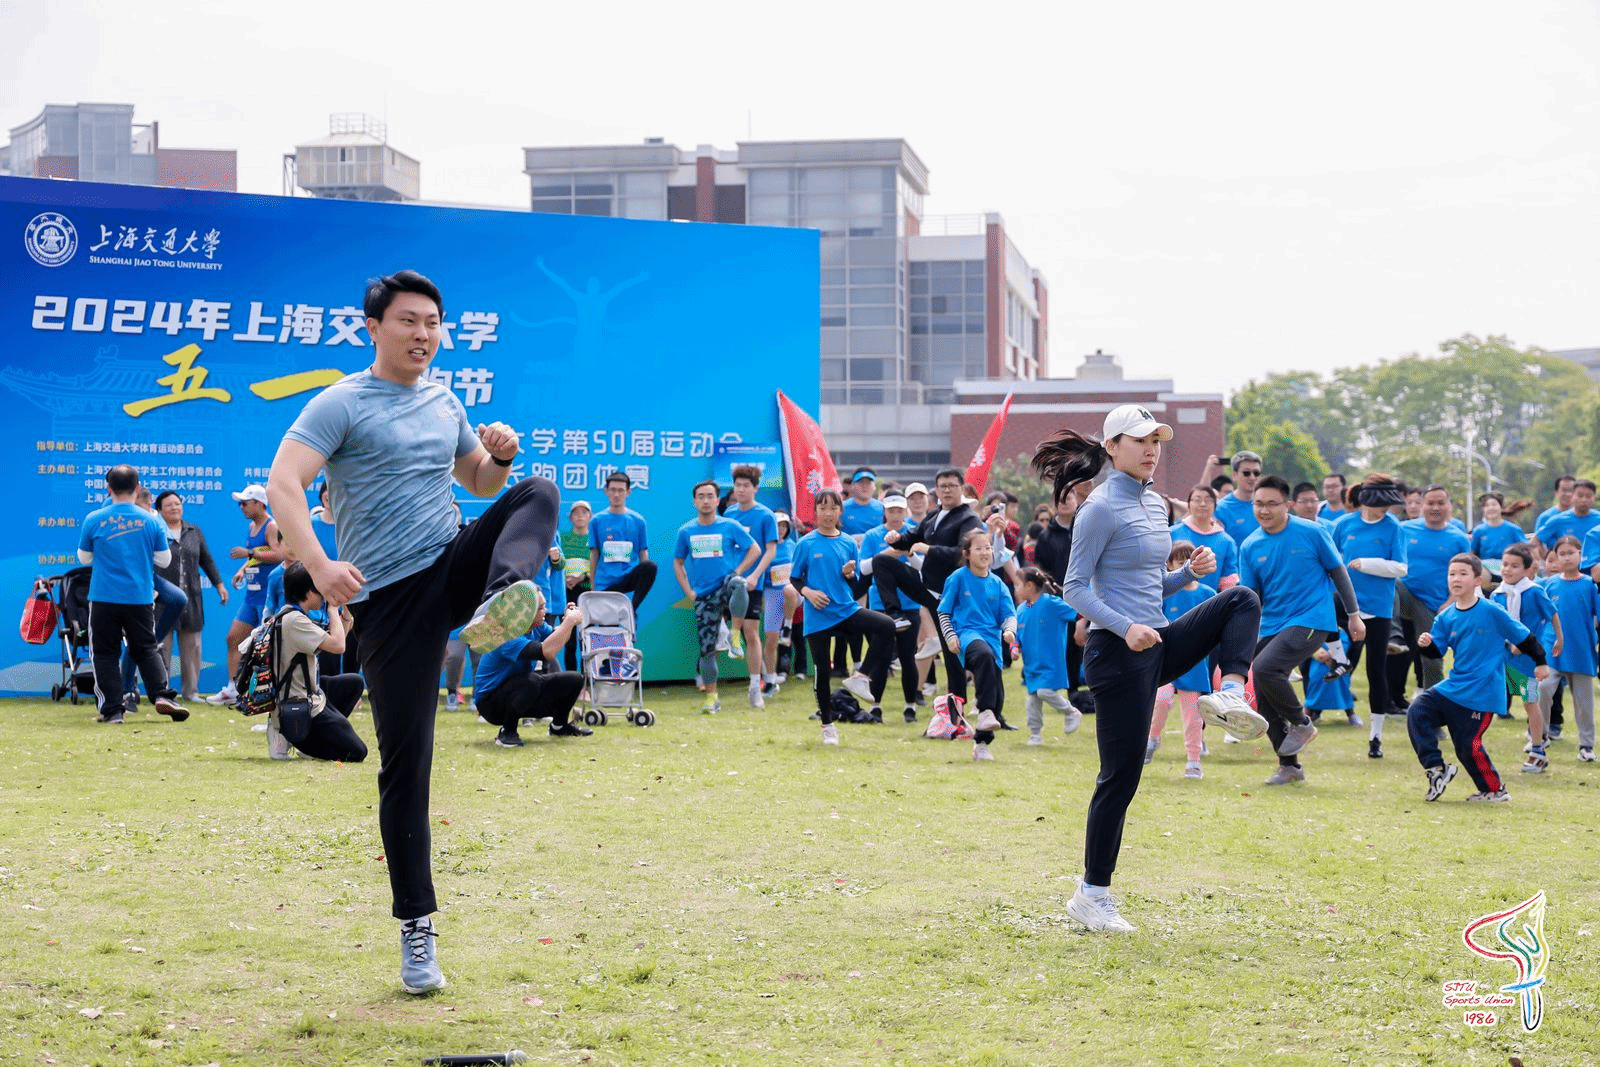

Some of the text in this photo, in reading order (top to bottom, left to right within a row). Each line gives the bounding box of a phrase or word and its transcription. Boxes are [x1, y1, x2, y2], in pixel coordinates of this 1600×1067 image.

[89, 255, 223, 271] SHANGHAI JIAO TONG UNIVERSITY
[31, 295, 499, 351] 2024年上海交学
